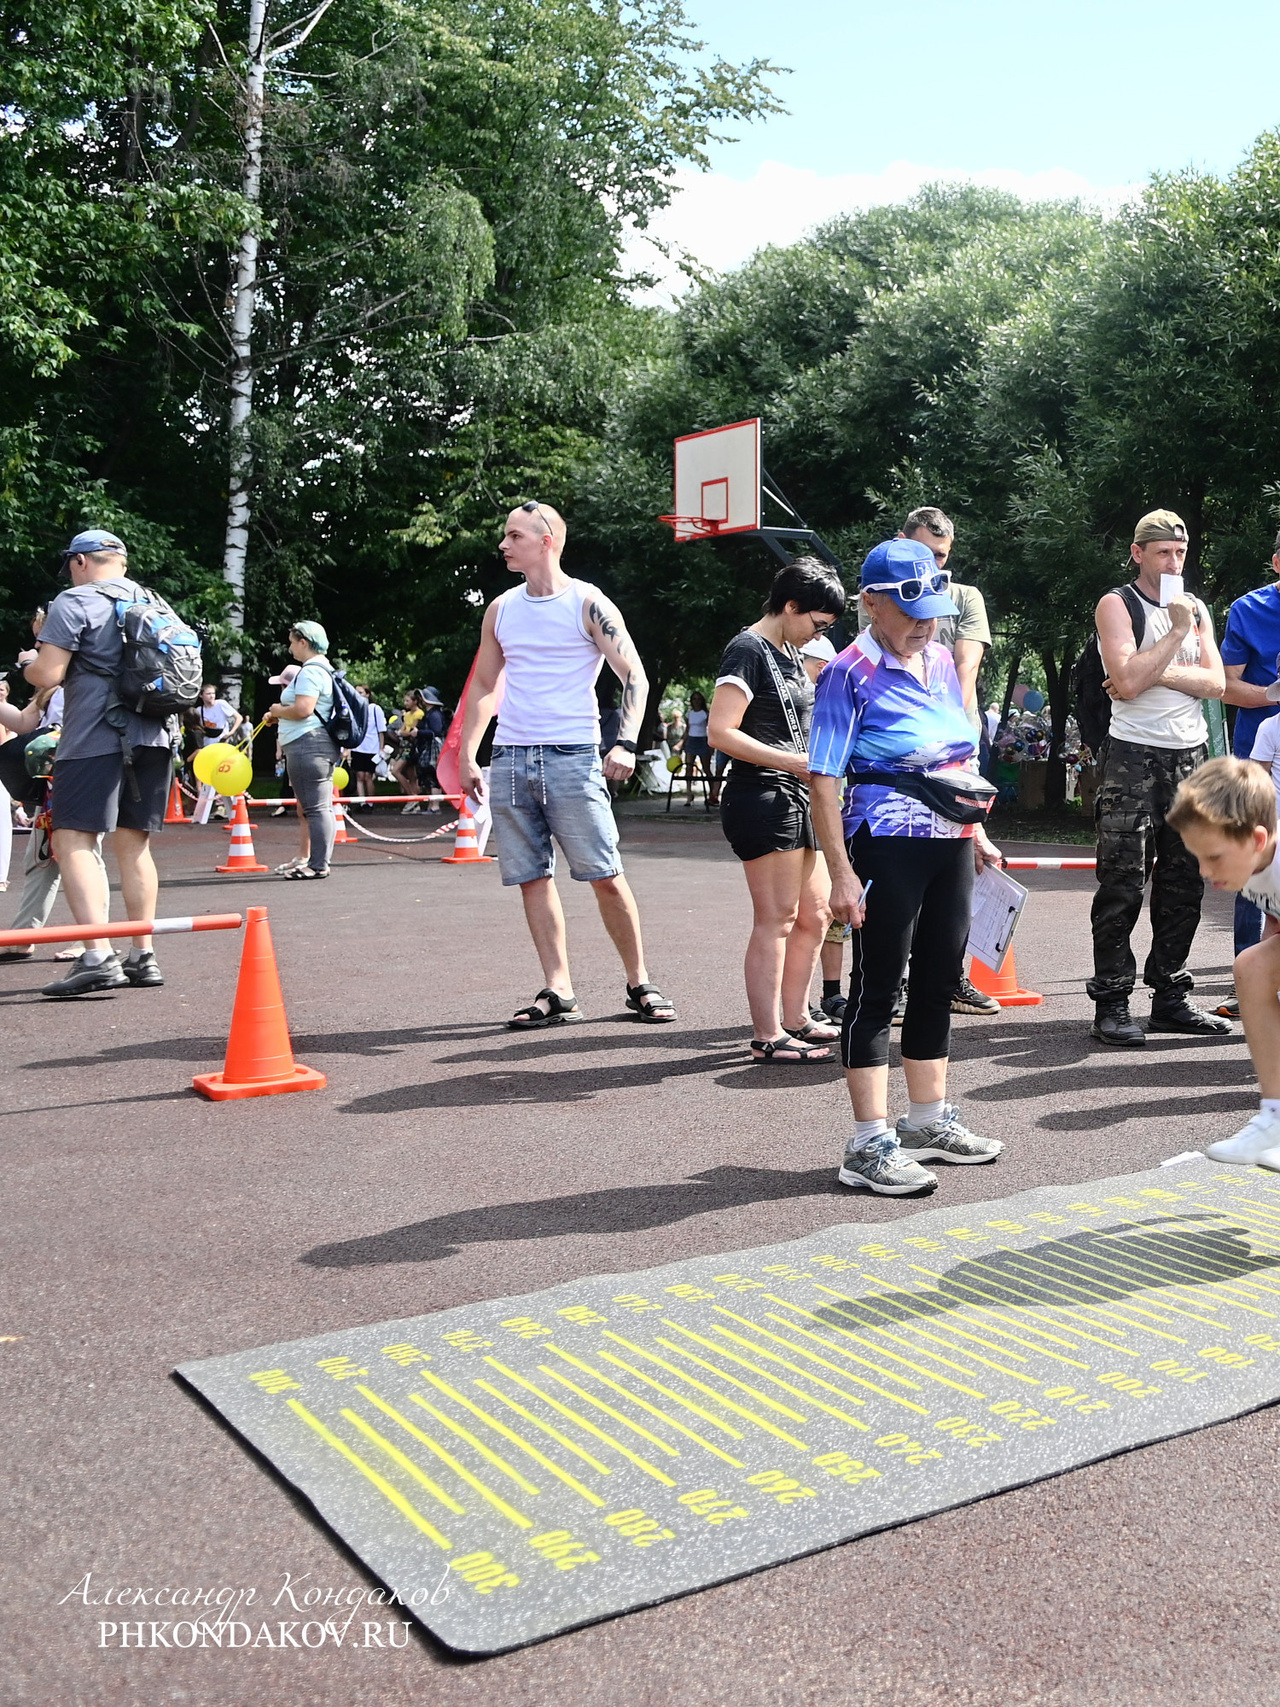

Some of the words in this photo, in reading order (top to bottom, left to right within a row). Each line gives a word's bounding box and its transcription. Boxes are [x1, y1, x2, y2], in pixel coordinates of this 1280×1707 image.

[763, 1264, 813, 1281] 210
[811, 1255, 860, 1271] 200
[665, 1284, 716, 1302] 230
[713, 1274, 766, 1292] 220
[557, 1305, 609, 1326] 250
[613, 1294, 663, 1313] 240
[501, 1317, 553, 1339] 260
[443, 1330, 494, 1352] 270
[381, 1343, 432, 1366] 280
[317, 1356, 369, 1380] 290
[249, 1369, 302, 1394] 300
[1096, 1372, 1163, 1398] 200
[1043, 1386, 1111, 1414] 210
[989, 1401, 1057, 1430] 220
[934, 1417, 1002, 1447] 230
[874, 1433, 943, 1465] 240
[812, 1451, 882, 1484] 250
[746, 1470, 818, 1504] 260
[677, 1489, 749, 1525] 270
[603, 1508, 676, 1547] 280
[527, 1530, 601, 1571] 290
[450, 1551, 521, 1595] 300
